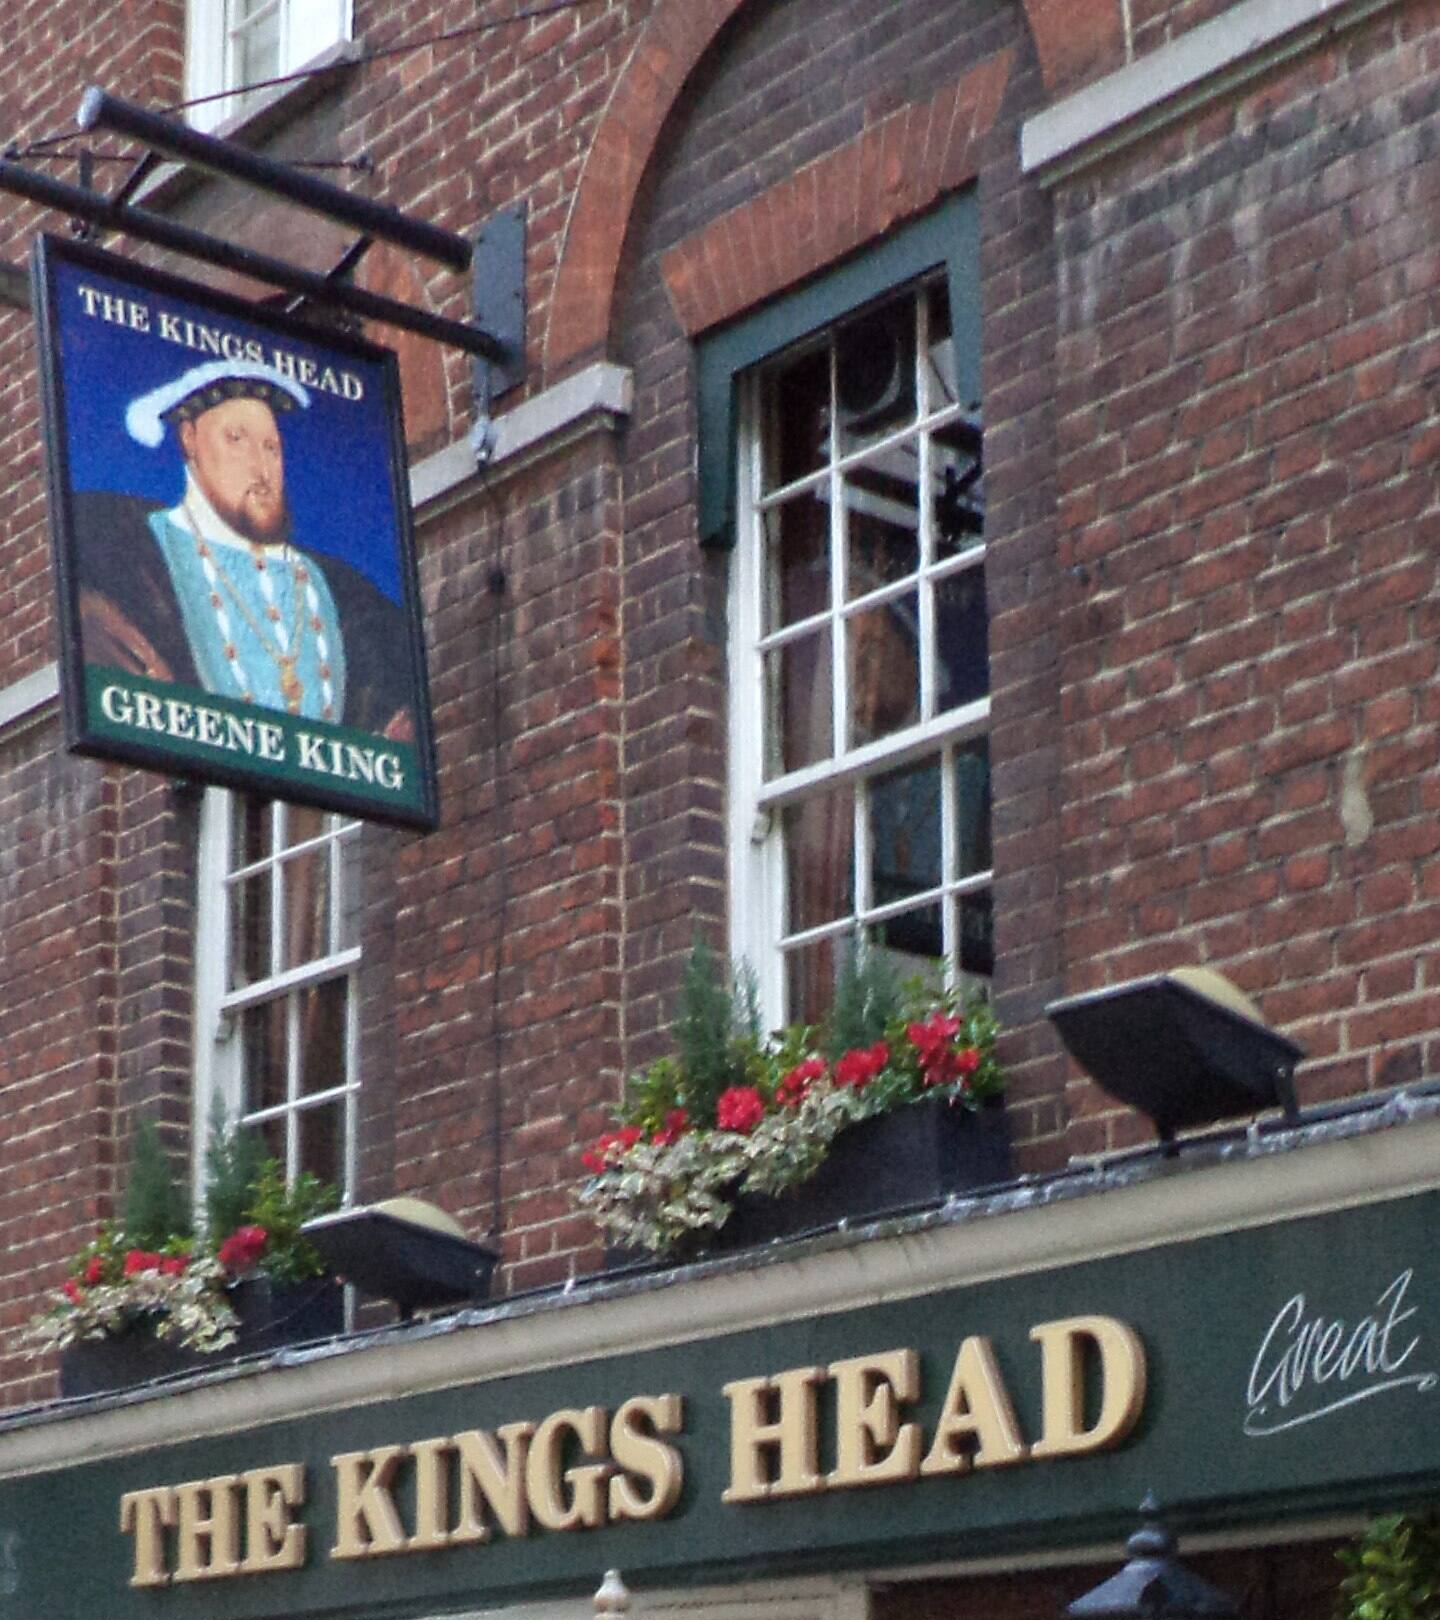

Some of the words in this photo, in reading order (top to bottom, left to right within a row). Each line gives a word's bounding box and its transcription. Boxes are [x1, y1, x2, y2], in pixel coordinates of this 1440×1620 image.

[77, 287, 151, 333] THE
[159, 312, 263, 366] KINGS
[274, 353, 363, 402] HEAD
[101, 685, 285, 763] GREENE
[298, 732, 405, 791] KING
[1243, 1265, 1422, 1414] Great
[120, 1462, 306, 1590] THE
[330, 1391, 684, 1563] KINGS
[720, 1313, 1150, 1504] HEAD
